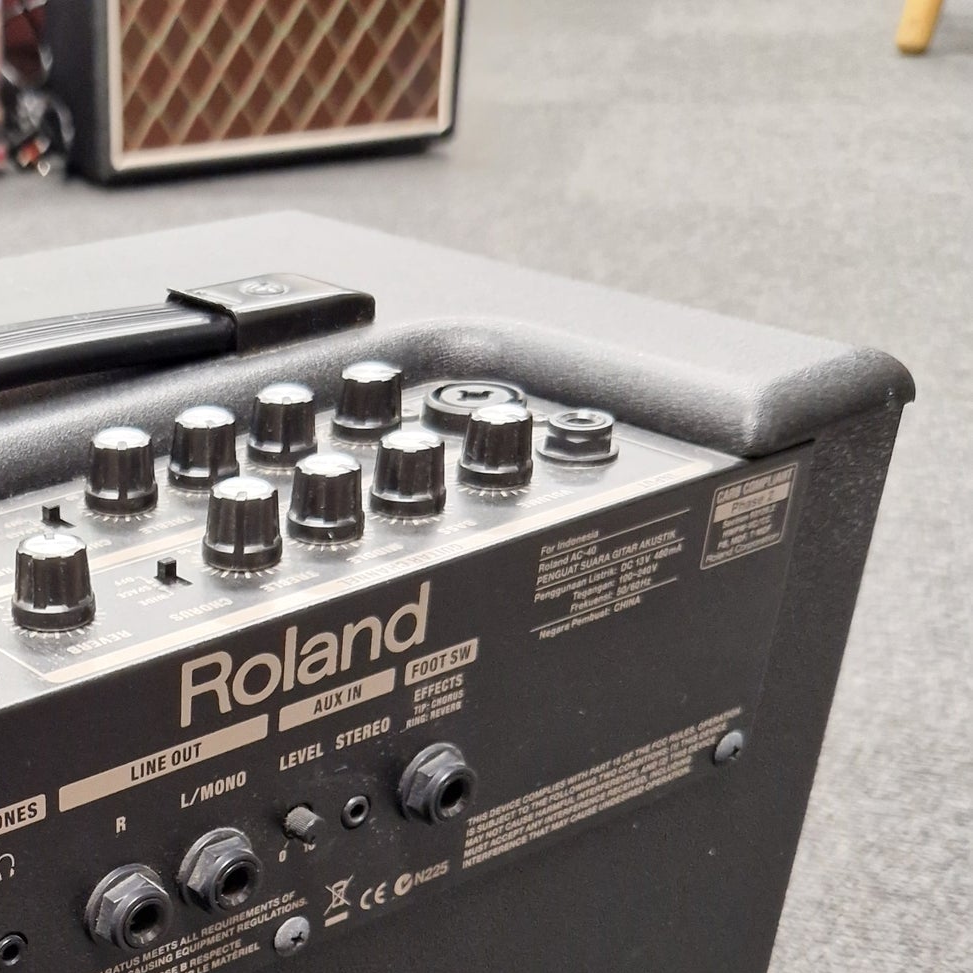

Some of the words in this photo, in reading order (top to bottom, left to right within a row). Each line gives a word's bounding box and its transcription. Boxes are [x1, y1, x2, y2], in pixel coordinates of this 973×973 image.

[437, 519, 477, 536] BASS
[536, 562, 579, 586] PENGUAT
[580, 551, 610, 571] SUARA
[611, 542, 638, 560] GITAR
[639, 528, 677, 550] AKUSTIK
[538, 554, 568, 573] Roland
[569, 544, 597, 563] AC-40
[620, 559, 634, 573] DC
[168, 598, 233, 622] CHORUS
[613, 595, 640, 613] CHINA
[67, 629, 133, 655] REVERB
[180, 580, 429, 729] Roland
[410, 653, 447, 680] FOOT
[448, 645, 471, 665] SW
[312, 690, 344, 715] AUX
[346, 682, 363, 702] IN
[414, 673, 464, 703] EFFECTS
[431, 689, 464, 709] CHORUS
[430, 701, 462, 720] REVERB
[335, 716, 392, 750] STEREO
[129, 753, 166, 782] LINE
[169, 741, 203, 771] OUT
[279, 743, 324, 772] LEVEL
[180, 771, 247, 809] L/MONO
[467, 810, 487, 827] THIS
[489, 796, 521, 818] DEVICE
[522, 778, 565, 805] COMPLIES
[567, 769, 588, 787] WITH
[589, 759, 611, 778] PART
[622, 750, 634, 764] OF
[651, 736, 667, 752] FCC
[466, 824, 476, 837] IS
[477, 808, 516, 833] SUBJECT
[518, 802, 529, 816] TO
[531, 795, 547, 811] THE
[549, 775, 597, 804] FOLLOWING
[598, 767, 616, 784] TWO
[115, 815, 127, 834] R
[462, 833, 527, 869] INTERFERENCE
[529, 824, 549, 841] THAT
[550, 816, 568, 833] MAY
[569, 804, 597, 825] CAUSE
[463, 839, 487, 859] MUST
[489, 824, 524, 848] ACCEPT
[525, 817, 542, 833] ANY
[543, 791, 606, 826] INTERFERENCE
[464, 831, 484, 848] MAY
[485, 823, 504, 839] NOT
[505, 810, 534, 831] CAUSE
[535, 794, 575, 819] HARMFUL
[278, 849, 287, 863] 0
[414, 860, 450, 887] N225
[142, 940, 177, 964] MEETS
[179, 931, 199, 948] ALL
[200, 897, 279, 939] REQUIREMENTS
[281, 890, 295, 905] OF
[175, 926, 234, 960] EQUIPMENT
[179, 961, 188, 973] B
[189, 938, 241, 969] RESPECTE
[211, 940, 260, 970] MATÉRIEL
